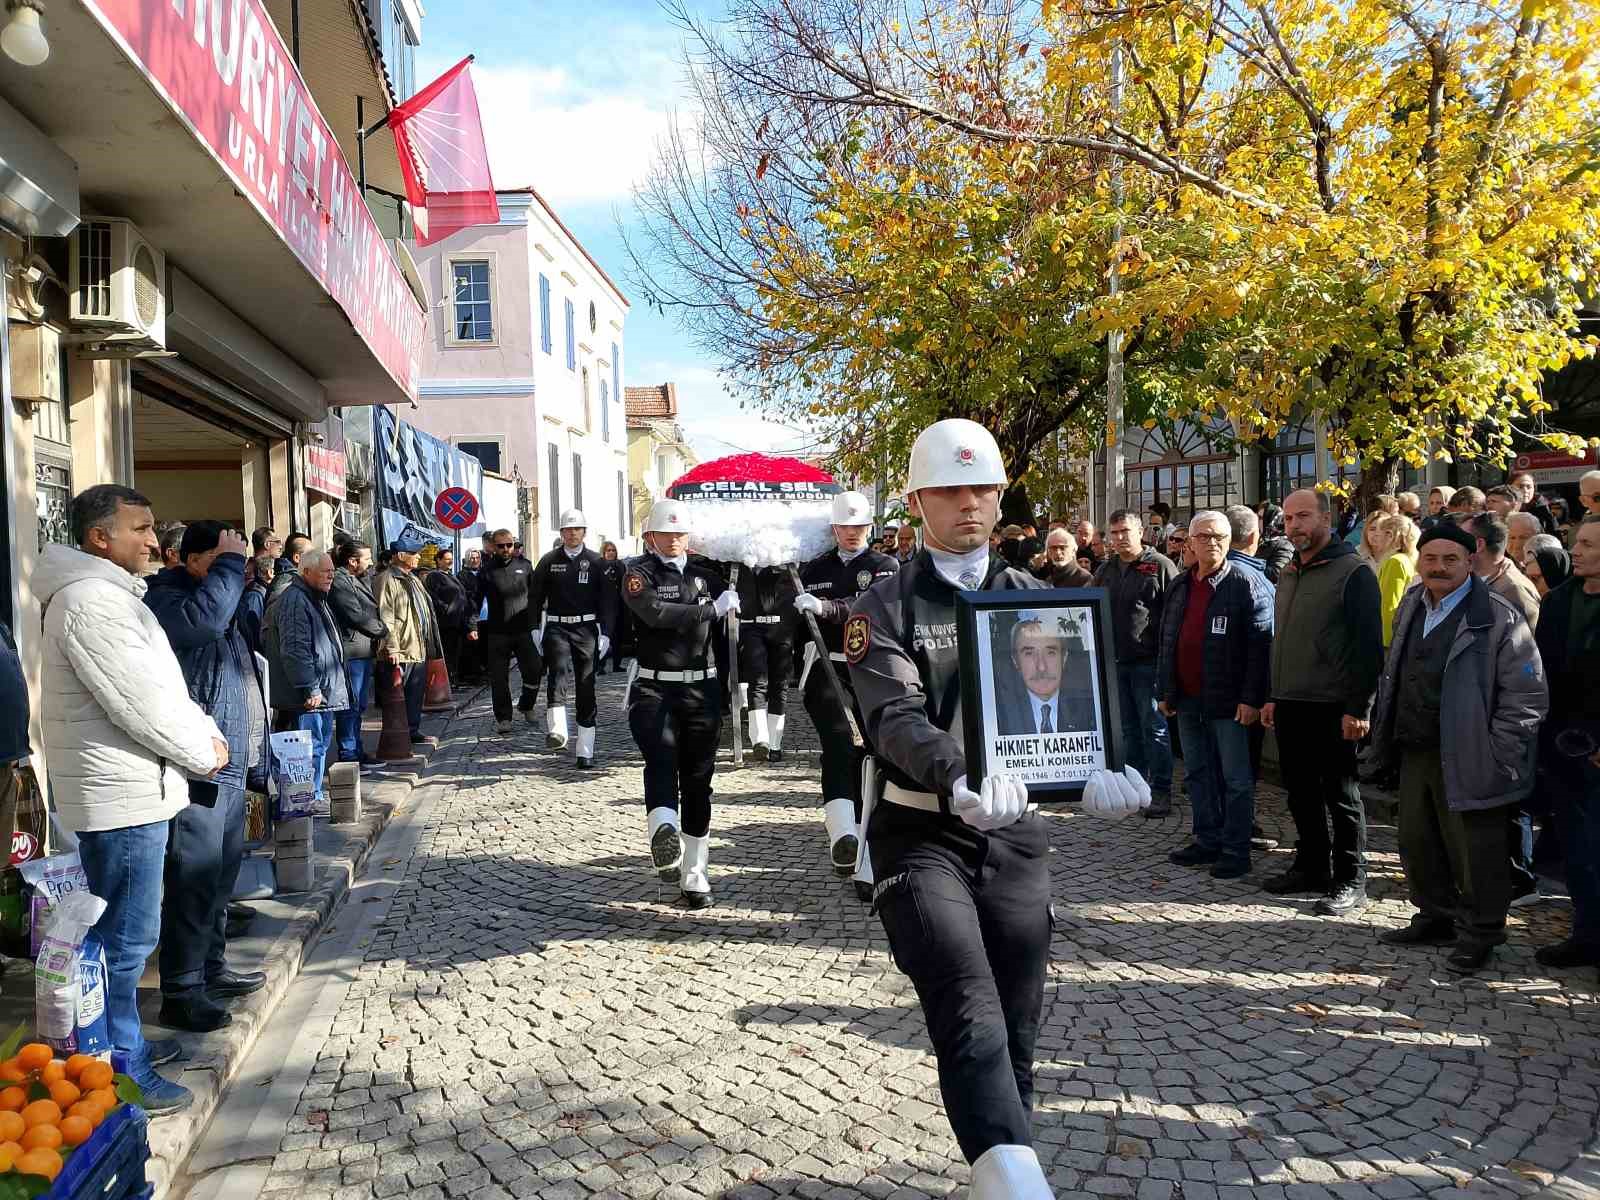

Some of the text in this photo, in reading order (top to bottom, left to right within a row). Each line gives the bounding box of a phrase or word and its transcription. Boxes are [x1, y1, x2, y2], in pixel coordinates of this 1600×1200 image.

[228, 111, 280, 212] URLA
[700, 481, 820, 492] CELAL SEL
[995, 731, 1103, 757] HİKMET KARANFİL
[1006, 754, 1095, 768] EMEKLİ KOMİSER
[46, 880, 73, 896] Pro
